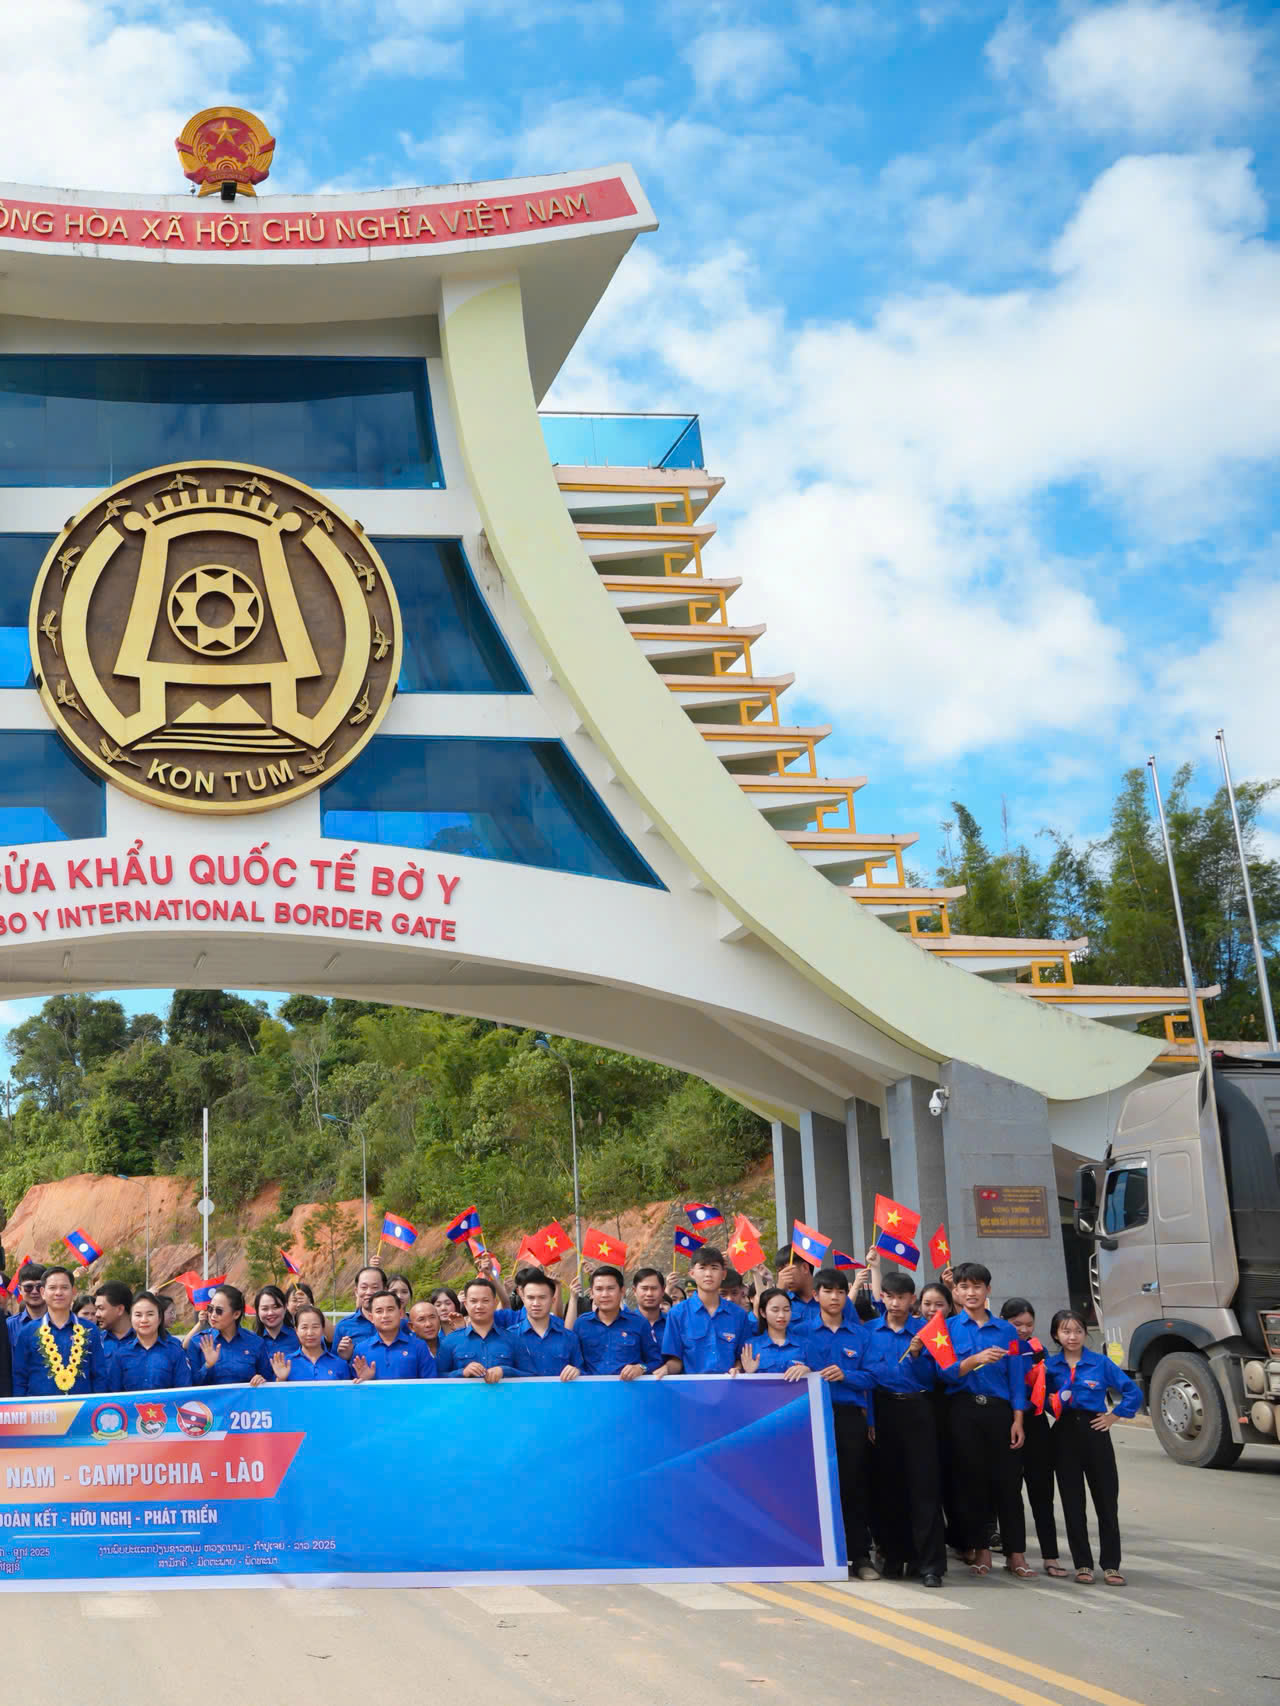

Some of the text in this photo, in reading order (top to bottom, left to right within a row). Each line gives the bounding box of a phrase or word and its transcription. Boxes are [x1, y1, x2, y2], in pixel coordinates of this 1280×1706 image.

[64, 208, 128, 239] HÒA
[141, 211, 186, 243] XÃ
[195, 212, 250, 246] HỘI
[262, 210, 326, 243] CHỦ
[336, 205, 436, 242] NGHĨA
[440, 201, 513, 238] VIỆT
[525, 192, 592, 225] NAM
[146, 758, 295, 795] KON TUM
[68, 839, 174, 889] KHẨU
[188, 842, 297, 888] QUỐC
[310, 849, 359, 893] TẾ
[370, 862, 426, 900] BỜ
[437, 875, 461, 905] Y
[33, 911, 49, 930] Y
[58, 898, 265, 928] INTERNATIONAL
[274, 903, 383, 932] BORDER
[391, 913, 457, 941] GATE
[229, 1411, 272, 1430] 2025
[7, 1466, 55, 1488] NAM
[79, 1462, 204, 1487] CAMPUCHIA
[226, 1457, 265, 1483] LÀO
[34, 1508, 58, 1527] KẾT
[70, 1508, 96, 1527] HỮU
[100, 1510, 132, 1530] NGHỊ
[144, 1508, 176, 1525] PHÁT
[179, 1504, 217, 1524] TRIỂN
[30, 1547, 50, 1557] 2025
[312, 1541, 336, 1549] 2025
